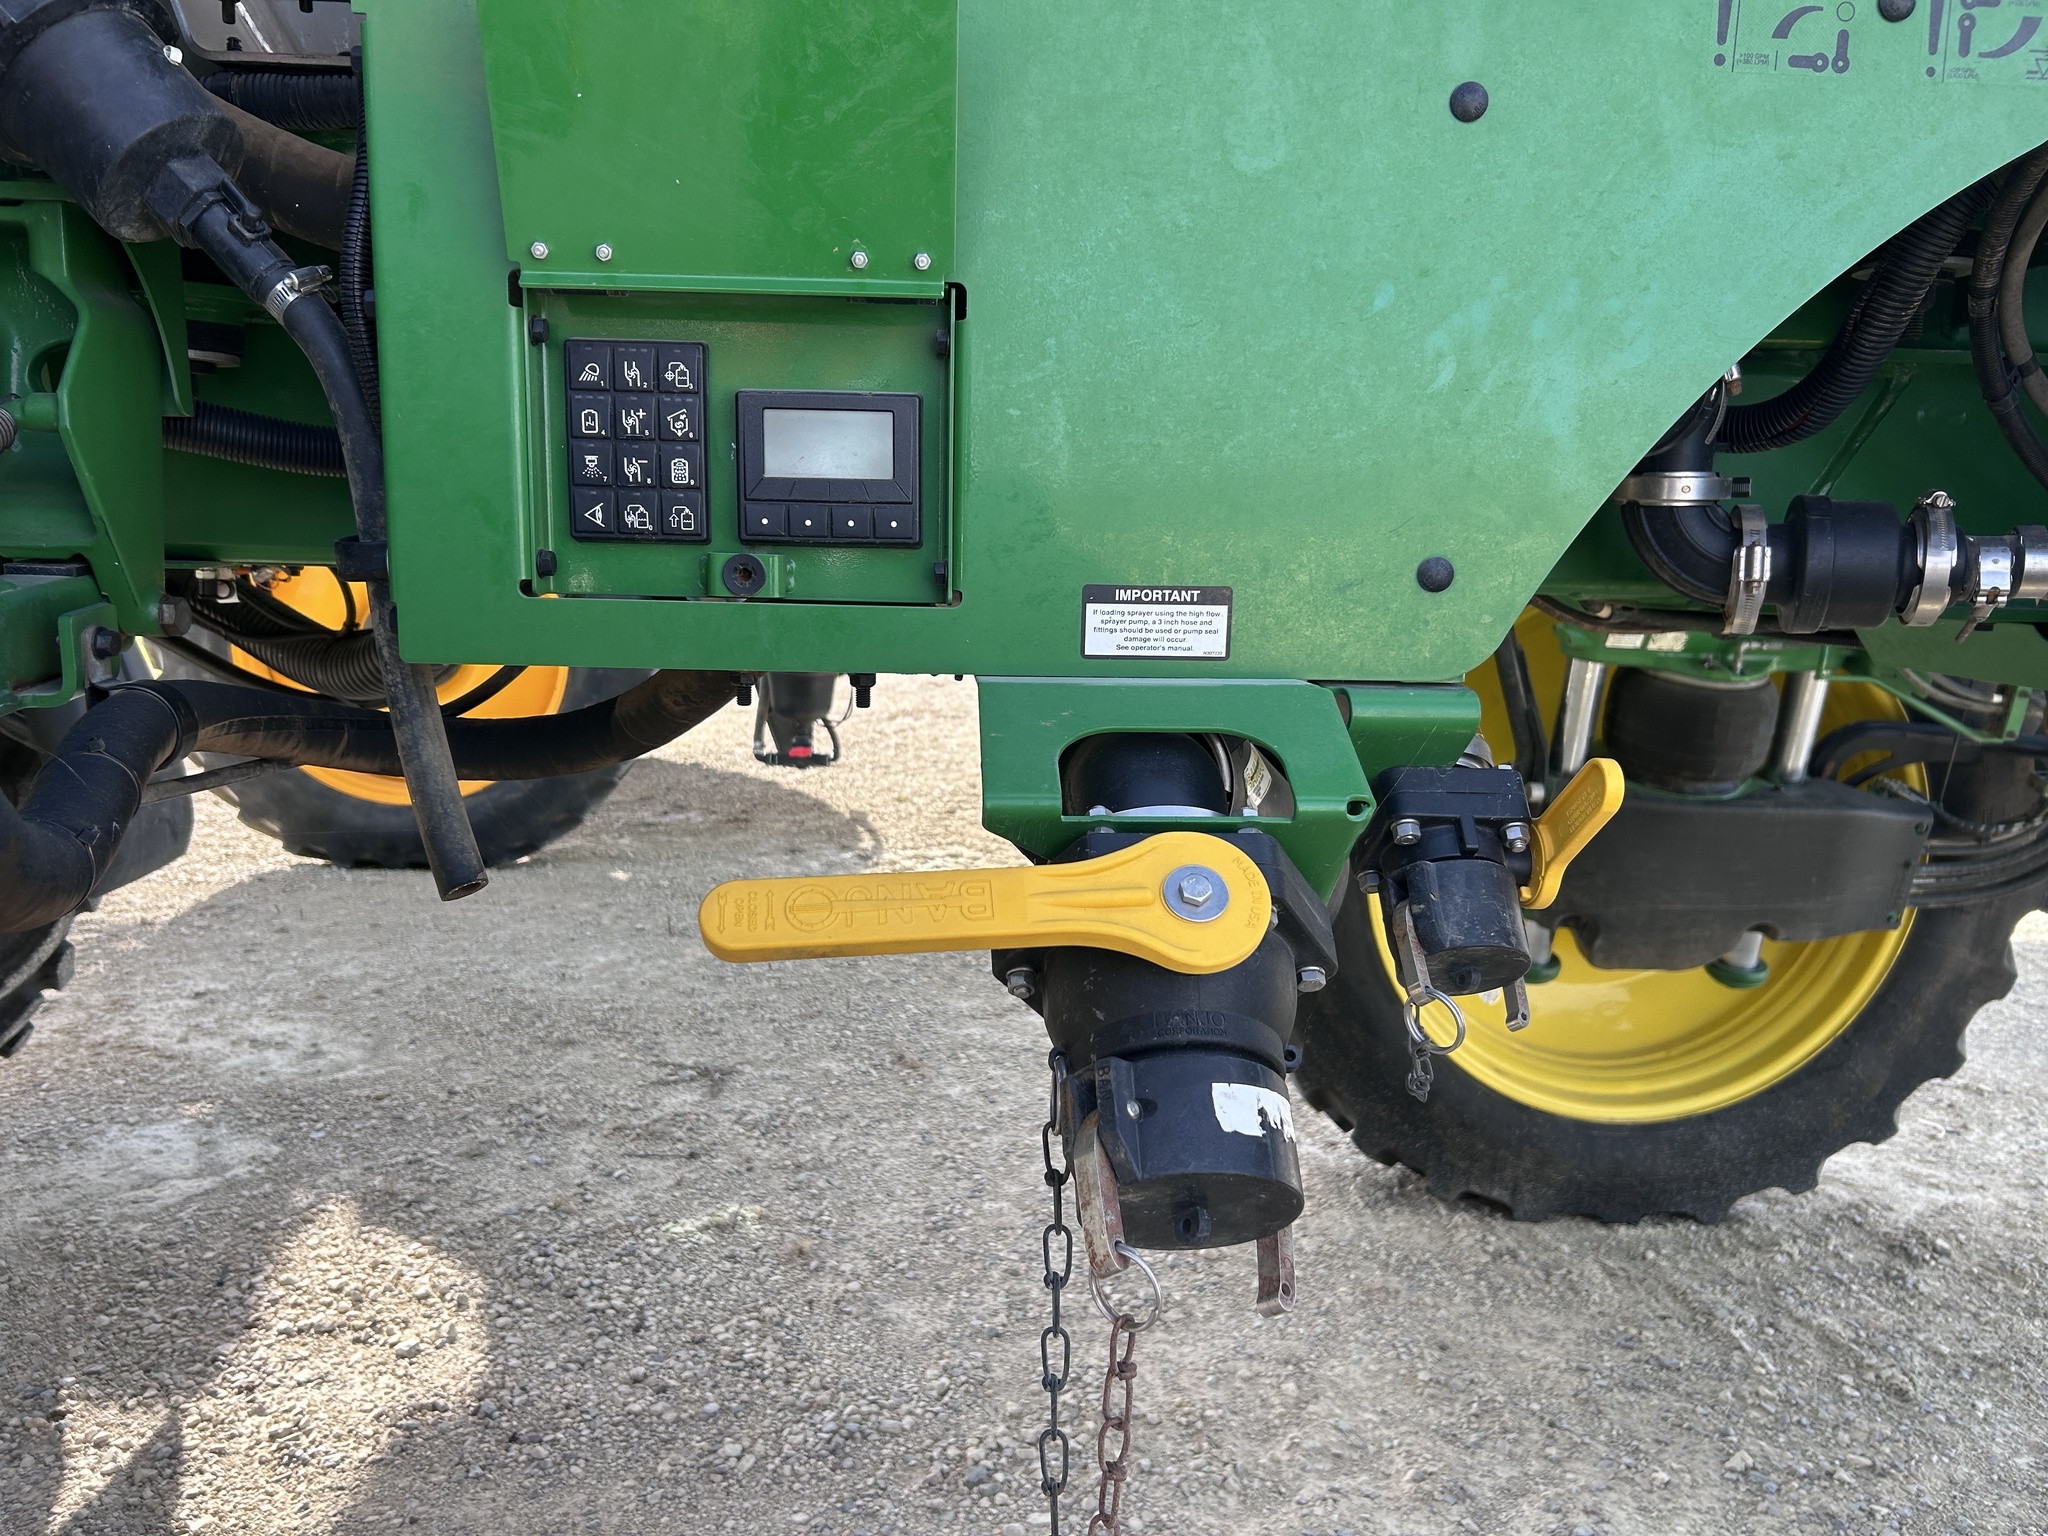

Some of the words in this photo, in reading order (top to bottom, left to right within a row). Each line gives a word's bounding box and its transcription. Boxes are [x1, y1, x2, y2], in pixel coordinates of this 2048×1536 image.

[1115, 589, 1201, 602] IMPORTANT
[1100, 609, 1125, 617] loading
[1155, 610, 1174, 618] using
[1232, 856, 1259, 888] MADE
[784, 879, 994, 933] BANJO
[1252, 891, 1263, 904] IN
[735, 897, 745, 927] OPEN
[748, 891, 758, 932] CLOSED
[1245, 906, 1261, 929] USA
[1153, 1008, 1226, 1028] BANJO
[1157, 1027, 1227, 1037] CORPORATION
